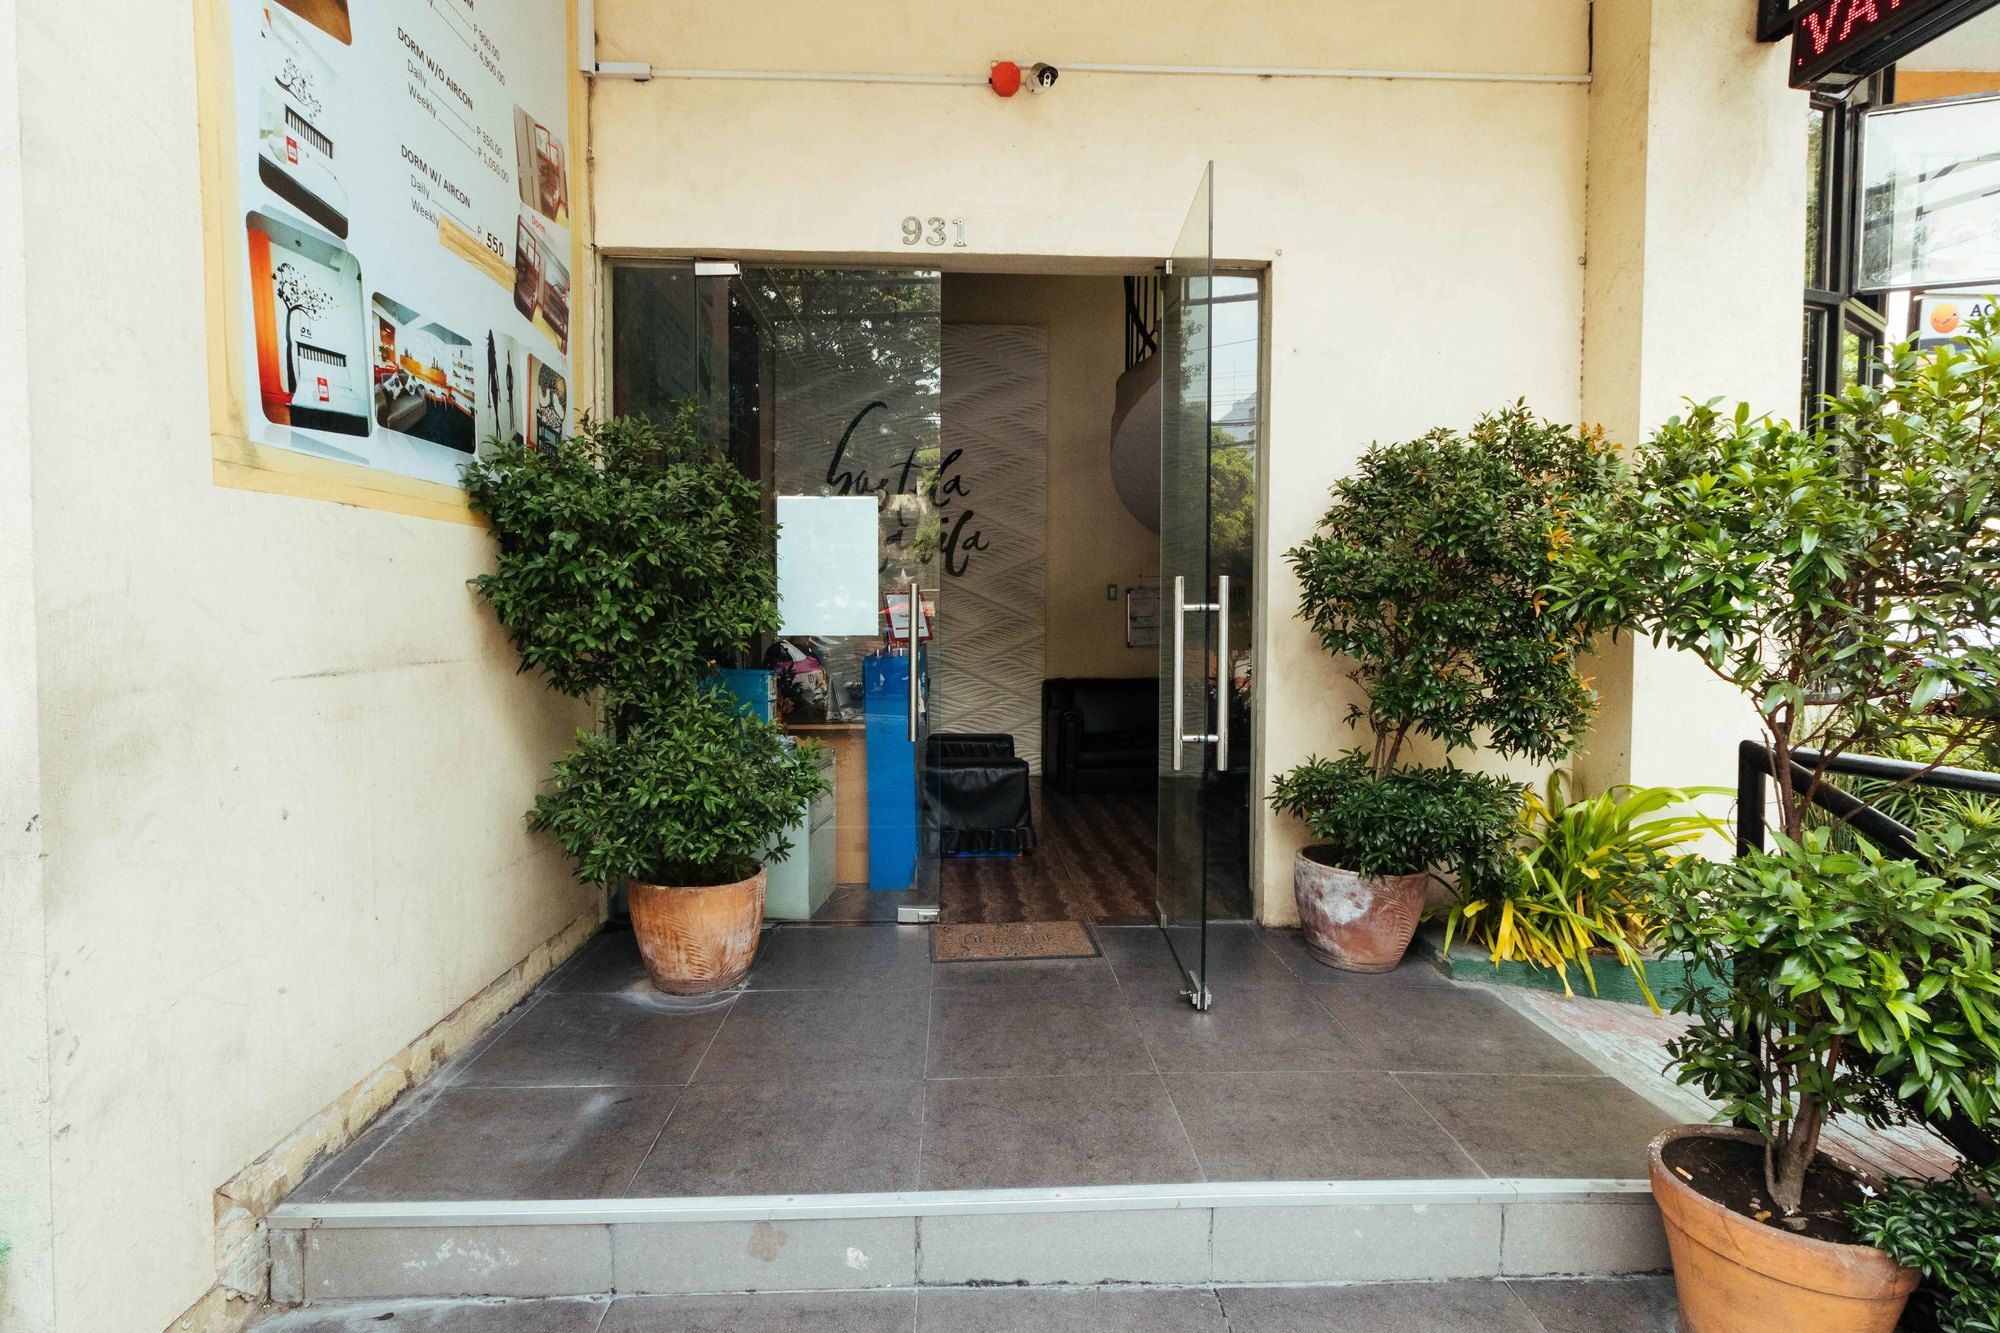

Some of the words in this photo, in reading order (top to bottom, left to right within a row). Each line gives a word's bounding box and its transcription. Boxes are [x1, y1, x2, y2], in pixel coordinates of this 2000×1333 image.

[1802, 0, 1900, 54] VA
[398, 26, 424, 62] DORM
[426, 55, 445, 81] W/O
[446, 76, 473, 111] AIRCON
[407, 59, 427, 88] Daily
[408, 81, 437, 119] Weekly
[401, 144, 428, 175] DORM
[443, 178, 471, 209] AIRCON
[410, 174, 430, 200] Daily
[486, 232, 504, 258] 550
[411, 196, 440, 229] Weekly
[901, 216, 967, 247] 931
